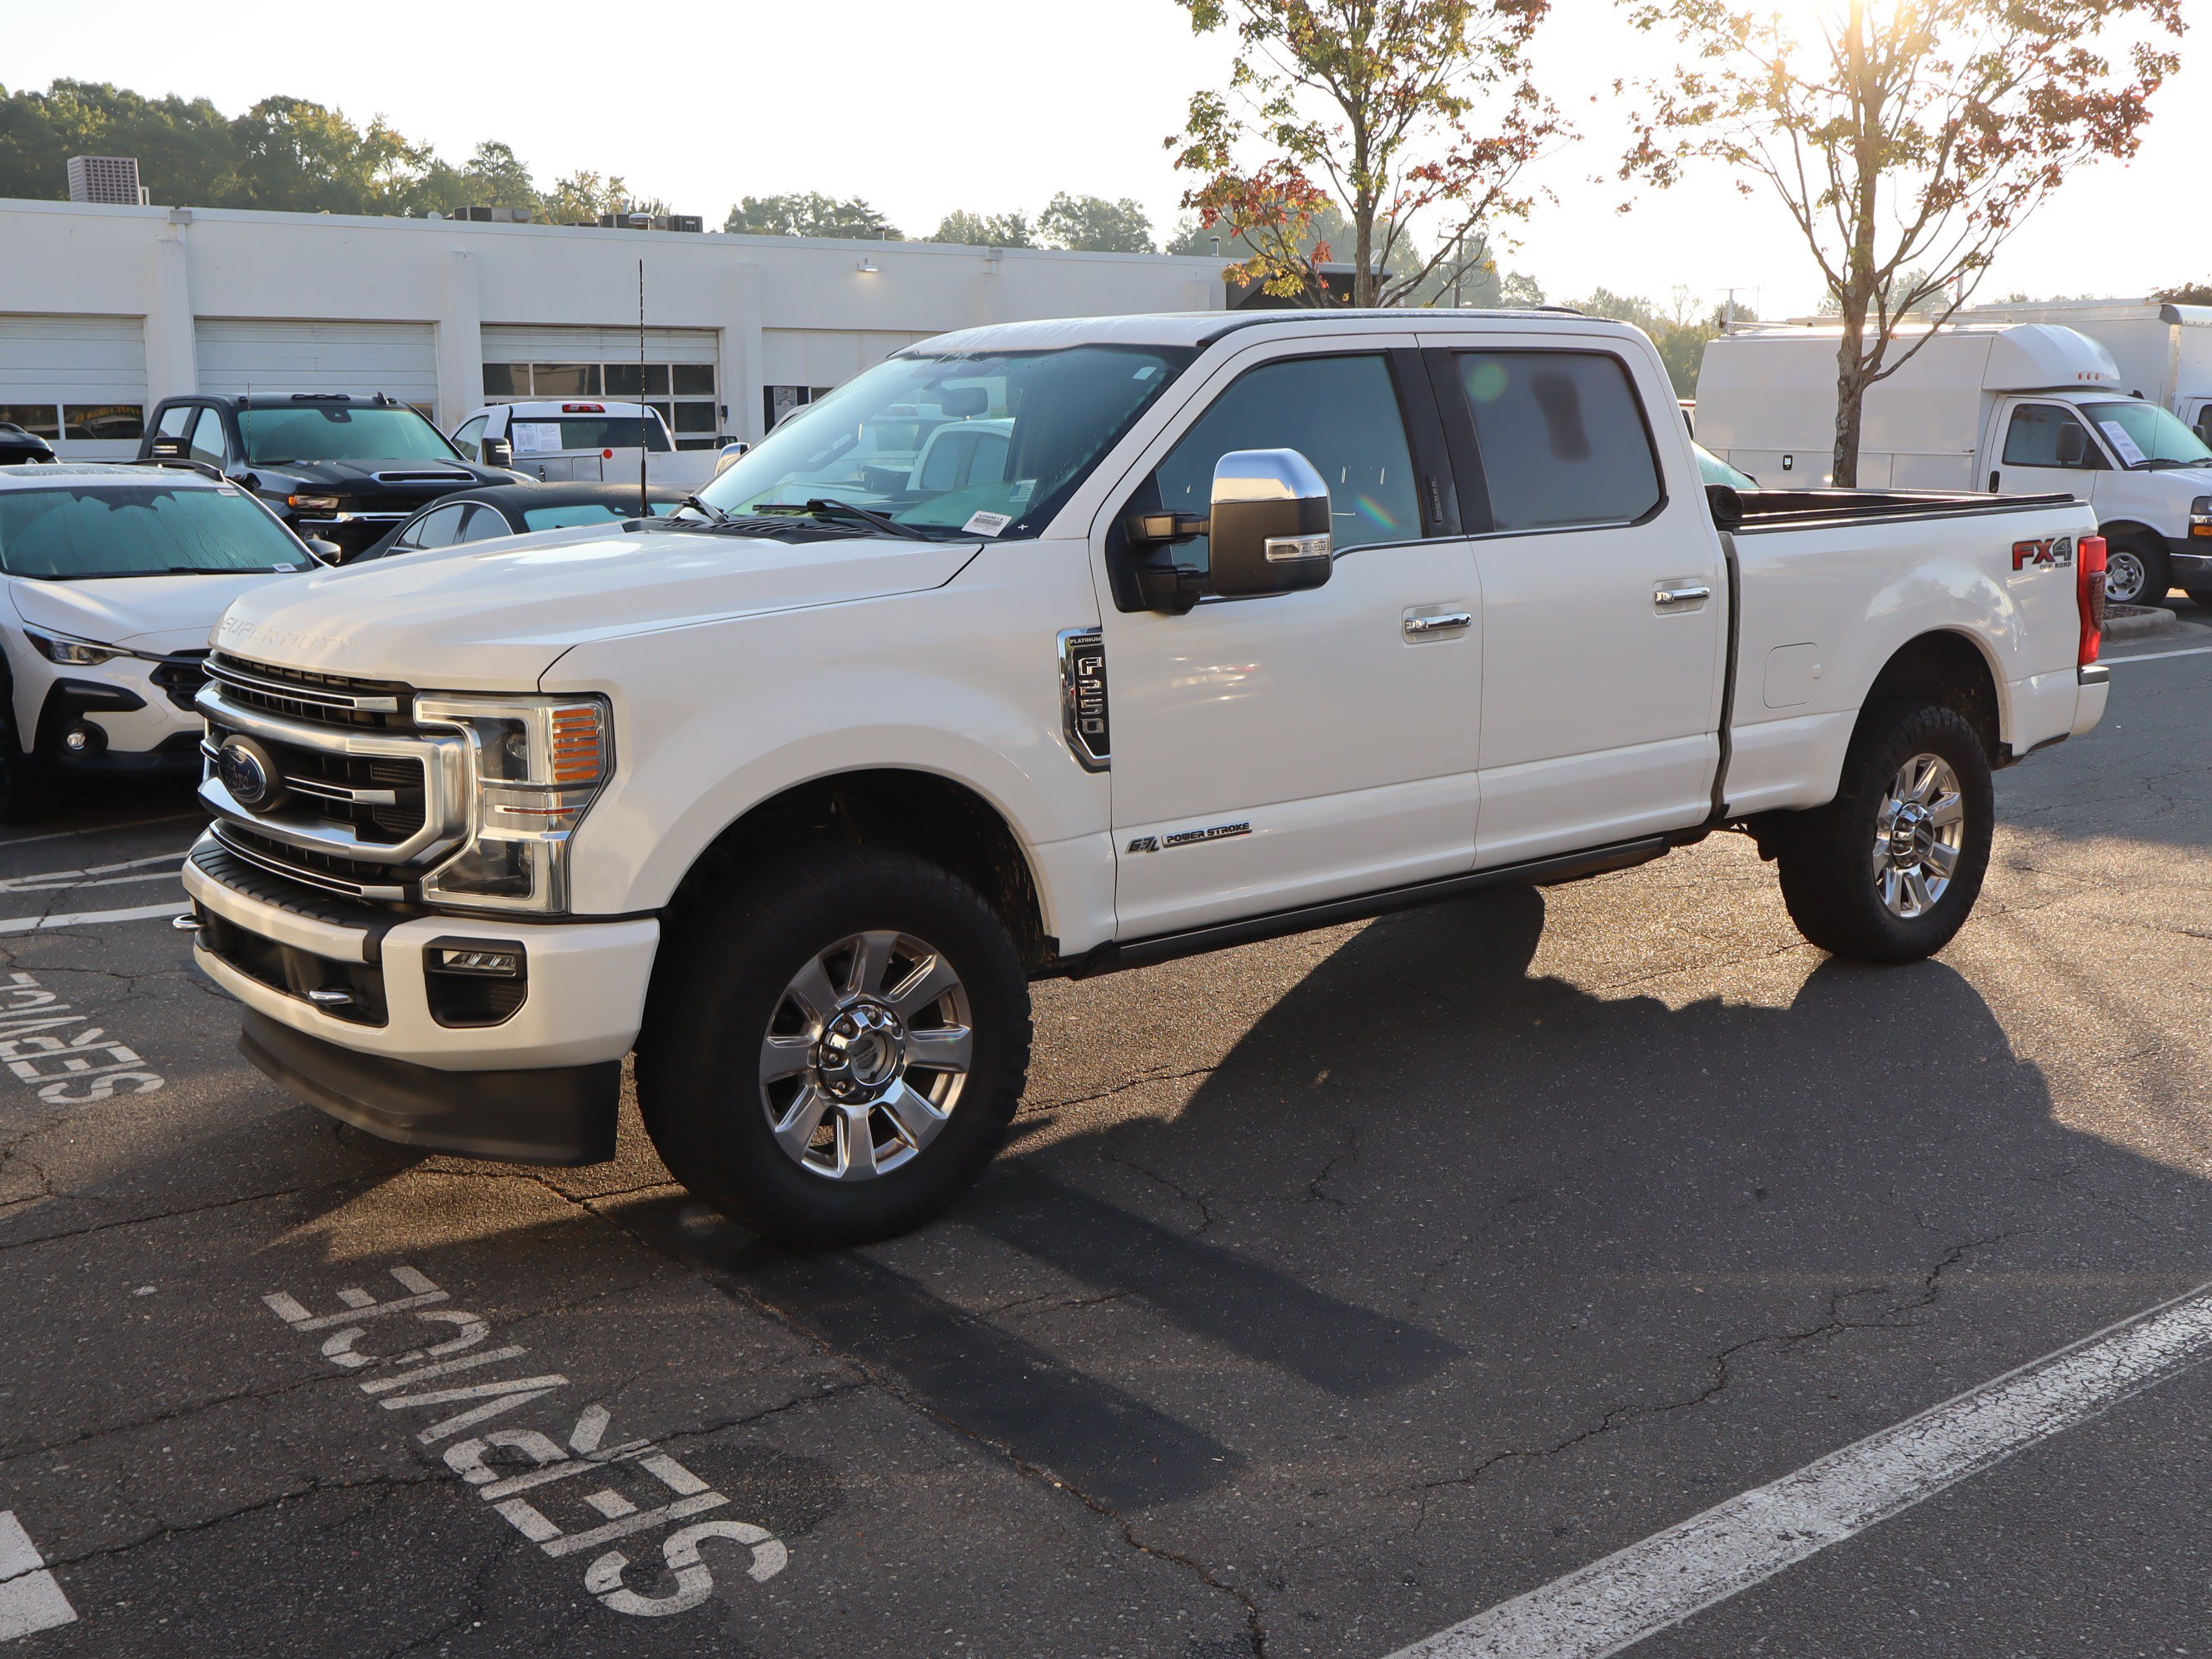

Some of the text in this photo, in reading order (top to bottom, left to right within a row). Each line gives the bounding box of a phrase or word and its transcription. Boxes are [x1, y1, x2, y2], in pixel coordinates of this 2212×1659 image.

[2011, 536, 2072, 572] FX4
[220, 616, 351, 654] SUPER DUTY
[1069, 636, 1103, 645] PLATINUM
[1078, 656, 1104, 734] F250
[1166, 830, 1205, 844] POWER
[1207, 822, 1250, 837] STROKE
[260, 1265, 789, 1617] SERVICE
